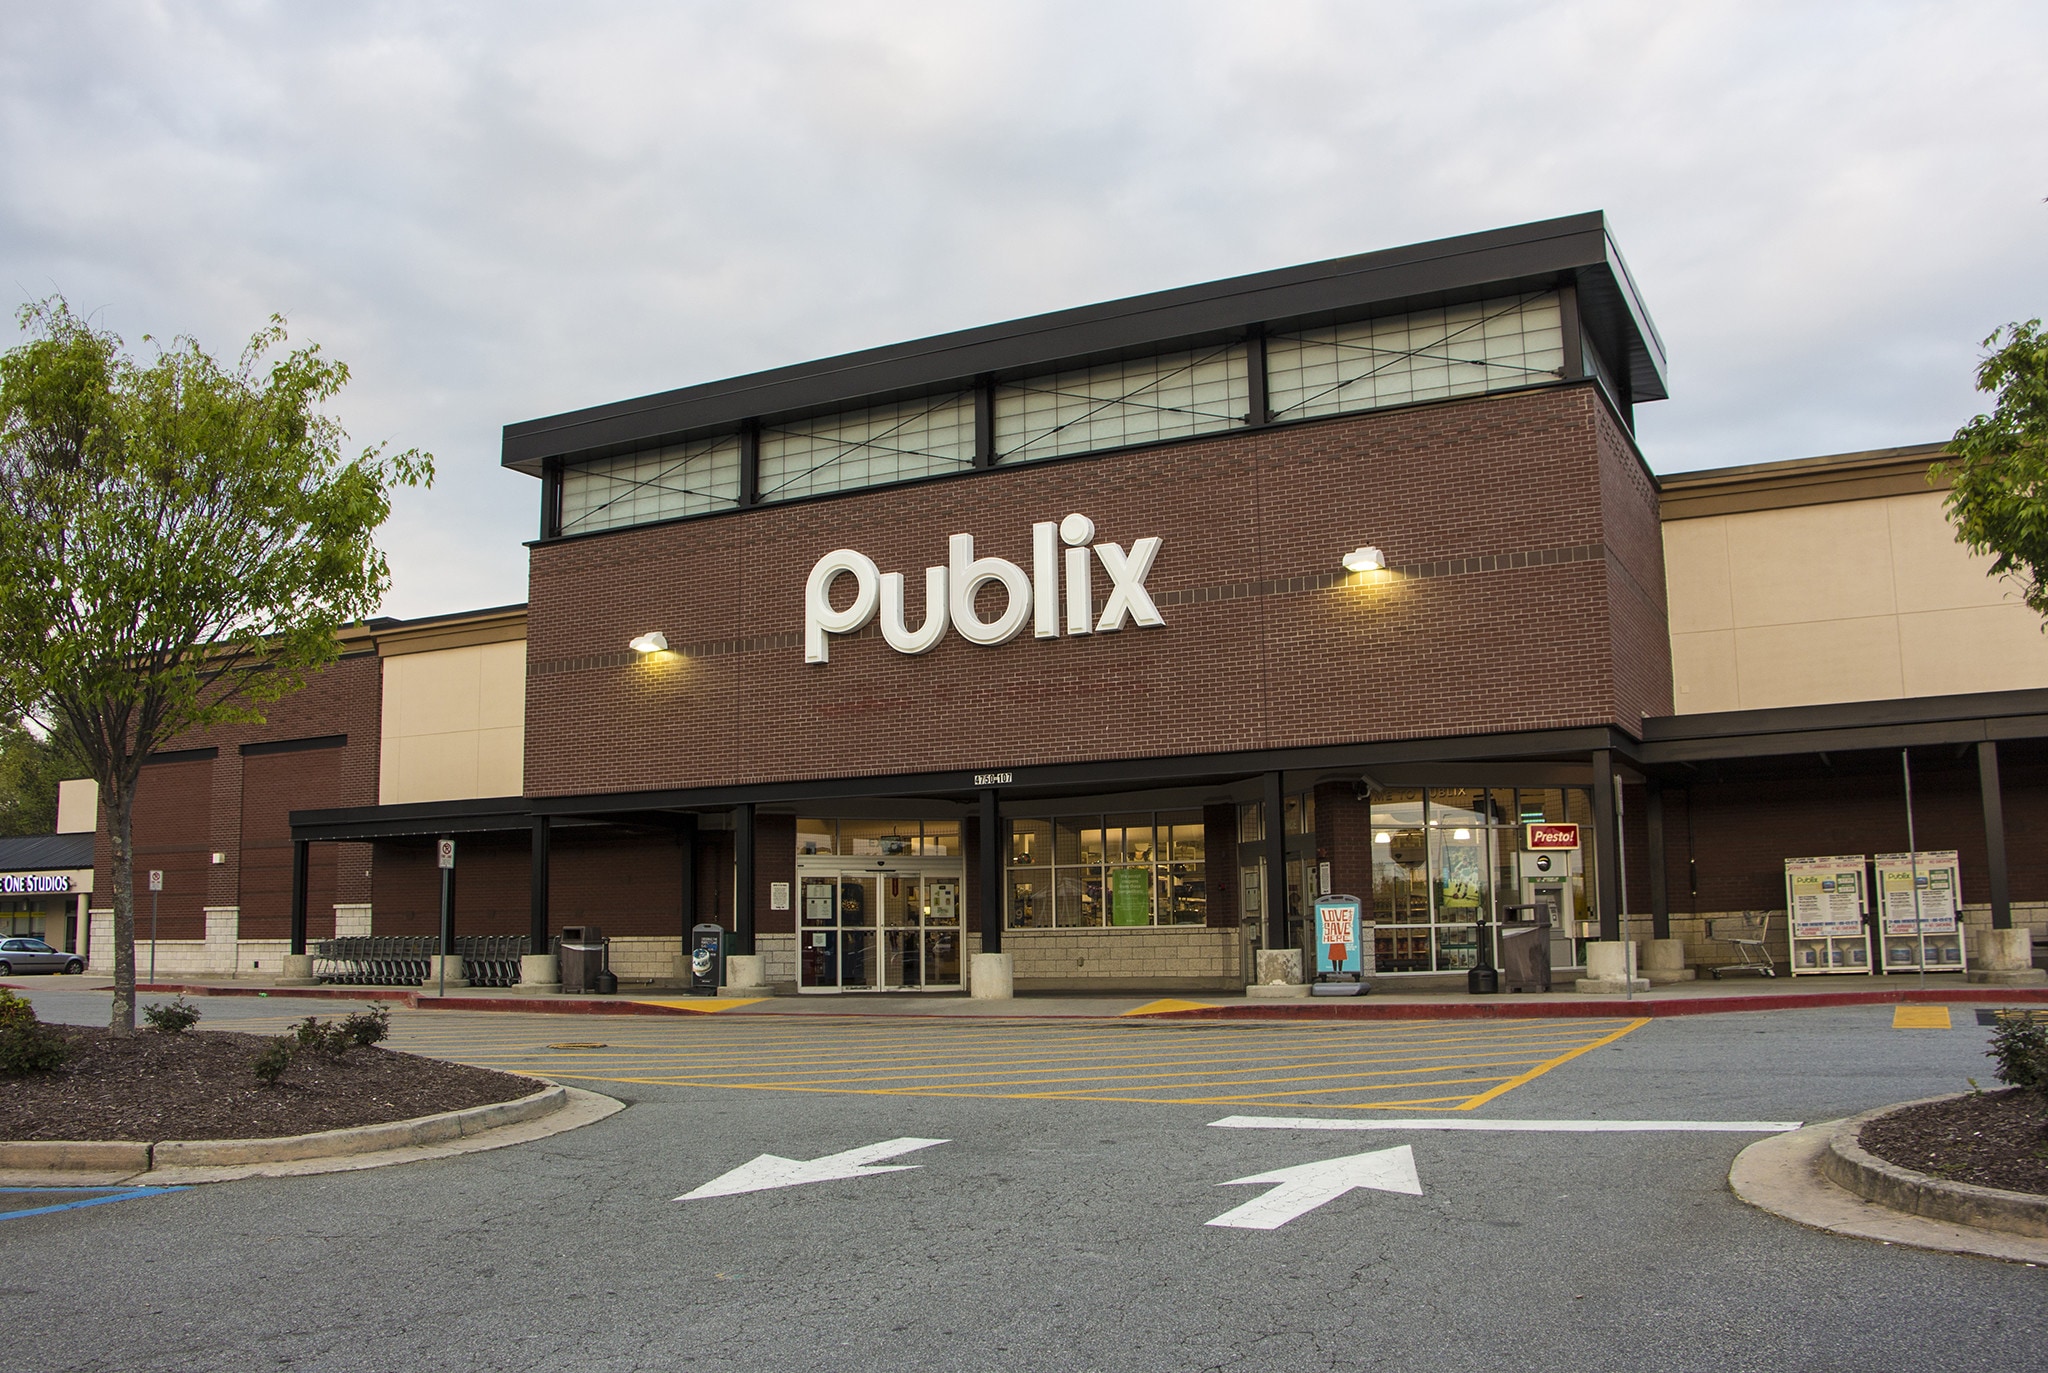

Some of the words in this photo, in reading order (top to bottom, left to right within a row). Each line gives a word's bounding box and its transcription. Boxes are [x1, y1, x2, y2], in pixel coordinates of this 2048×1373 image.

[805, 513, 1166, 664] Publix
[1430, 788, 1467, 798] UBLIX
[1534, 830, 1575, 842] Presto!
[4, 875, 25, 892] ONE
[26, 874, 68, 892] STUDIOS
[1321, 909, 1348, 922] LOVE
[1324, 922, 1351, 935] SAVE
